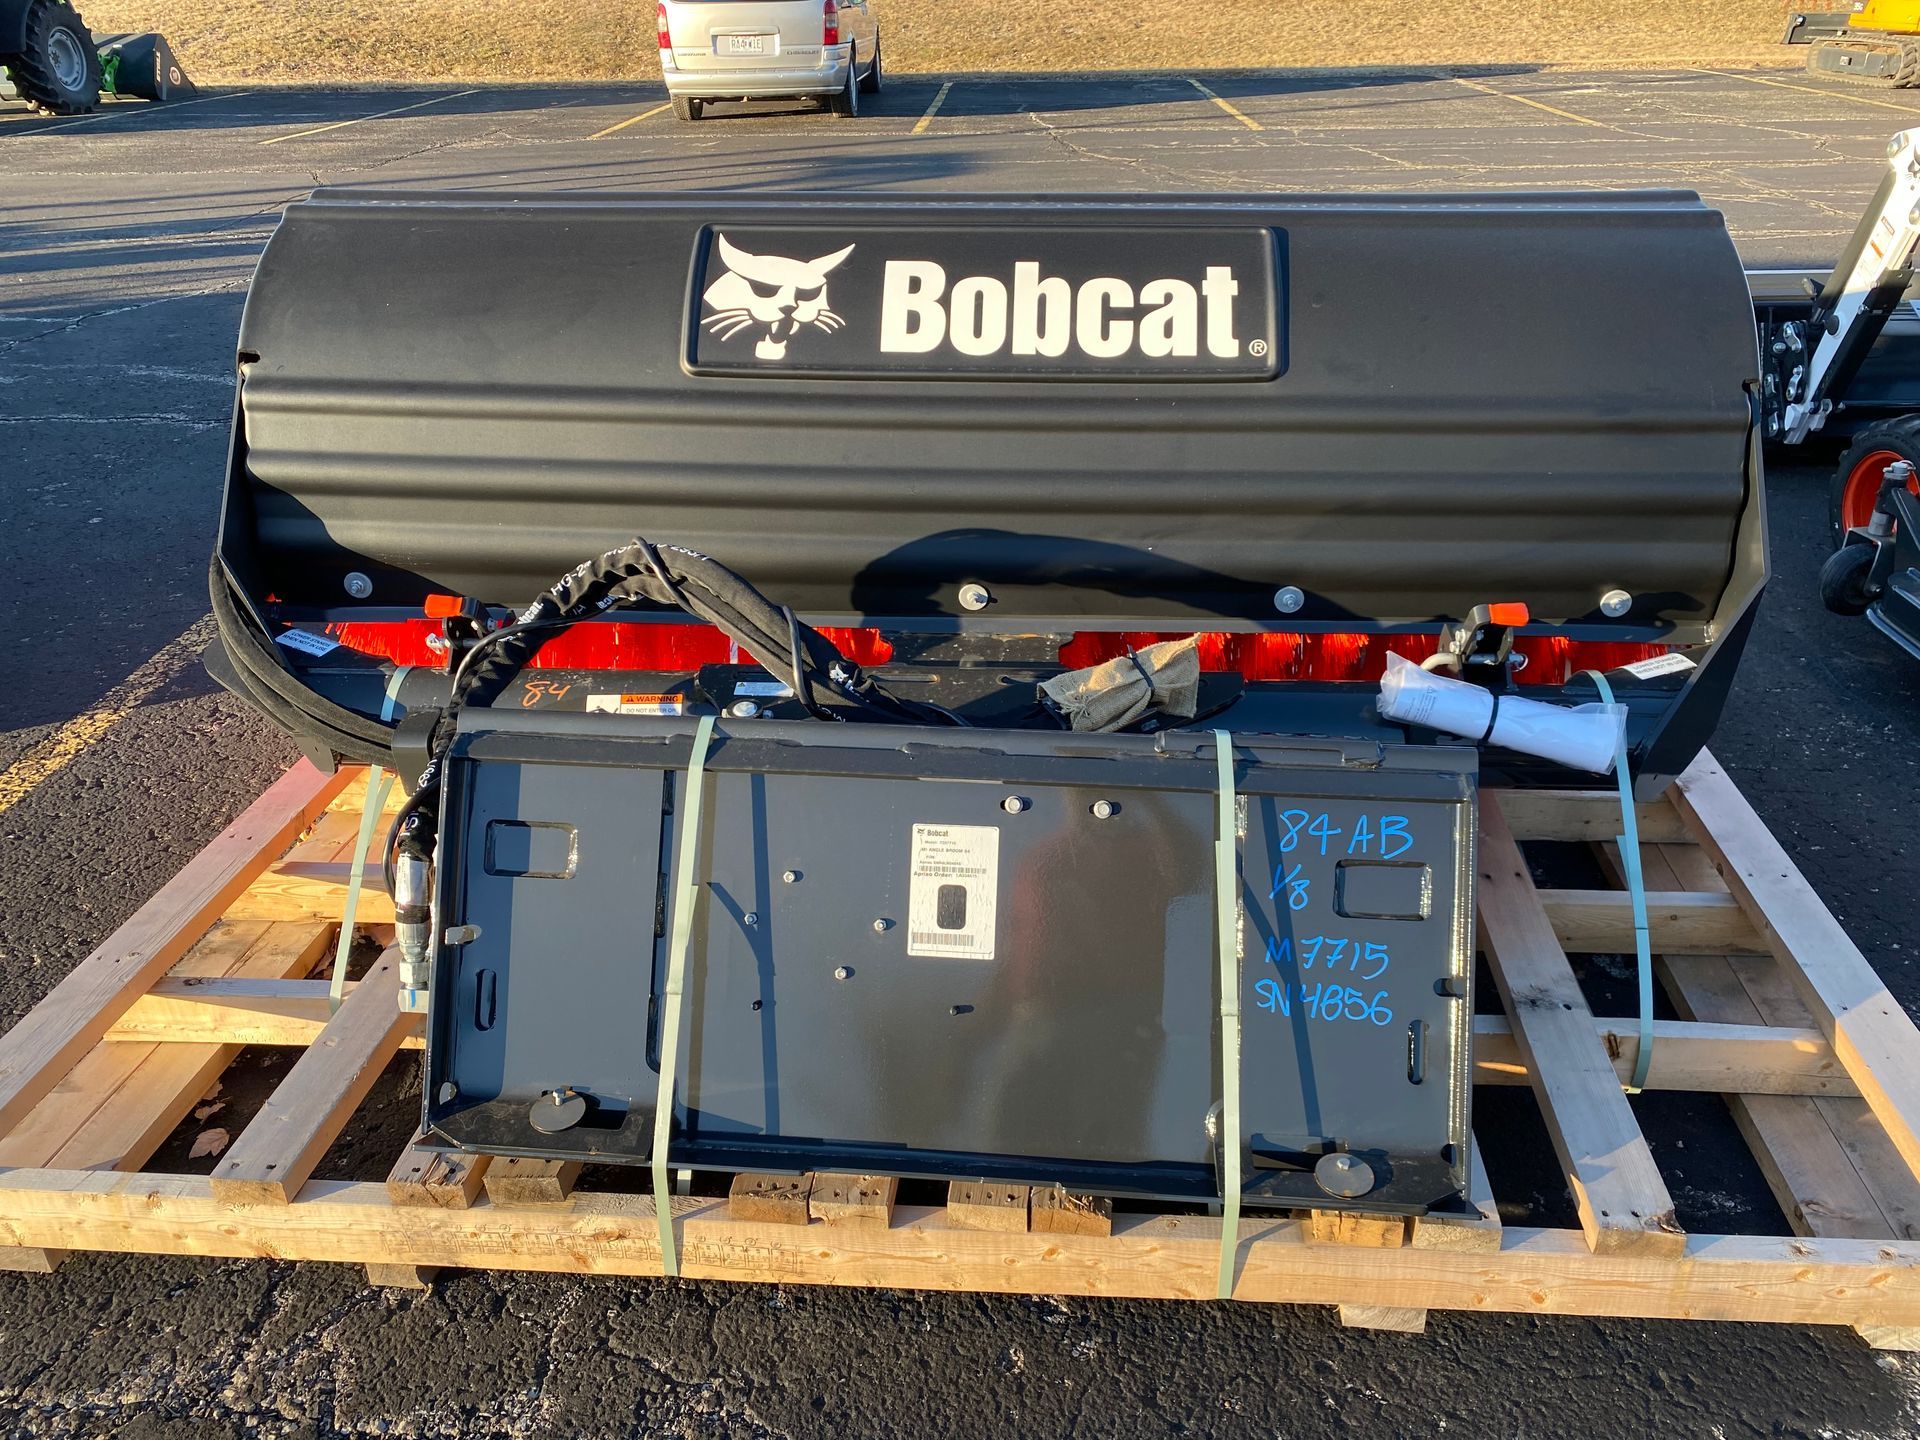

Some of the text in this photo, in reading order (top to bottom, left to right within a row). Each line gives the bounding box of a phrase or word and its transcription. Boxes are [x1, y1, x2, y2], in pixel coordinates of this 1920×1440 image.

[880, 260, 1240, 358] Bobcat
[522, 680, 573, 708] 84
[636, 695, 679, 703] WARNING
[927, 829, 949, 837] Bobcat
[1279, 809, 1414, 860] 84 AB
[1265, 935, 1390, 980] M 7715
